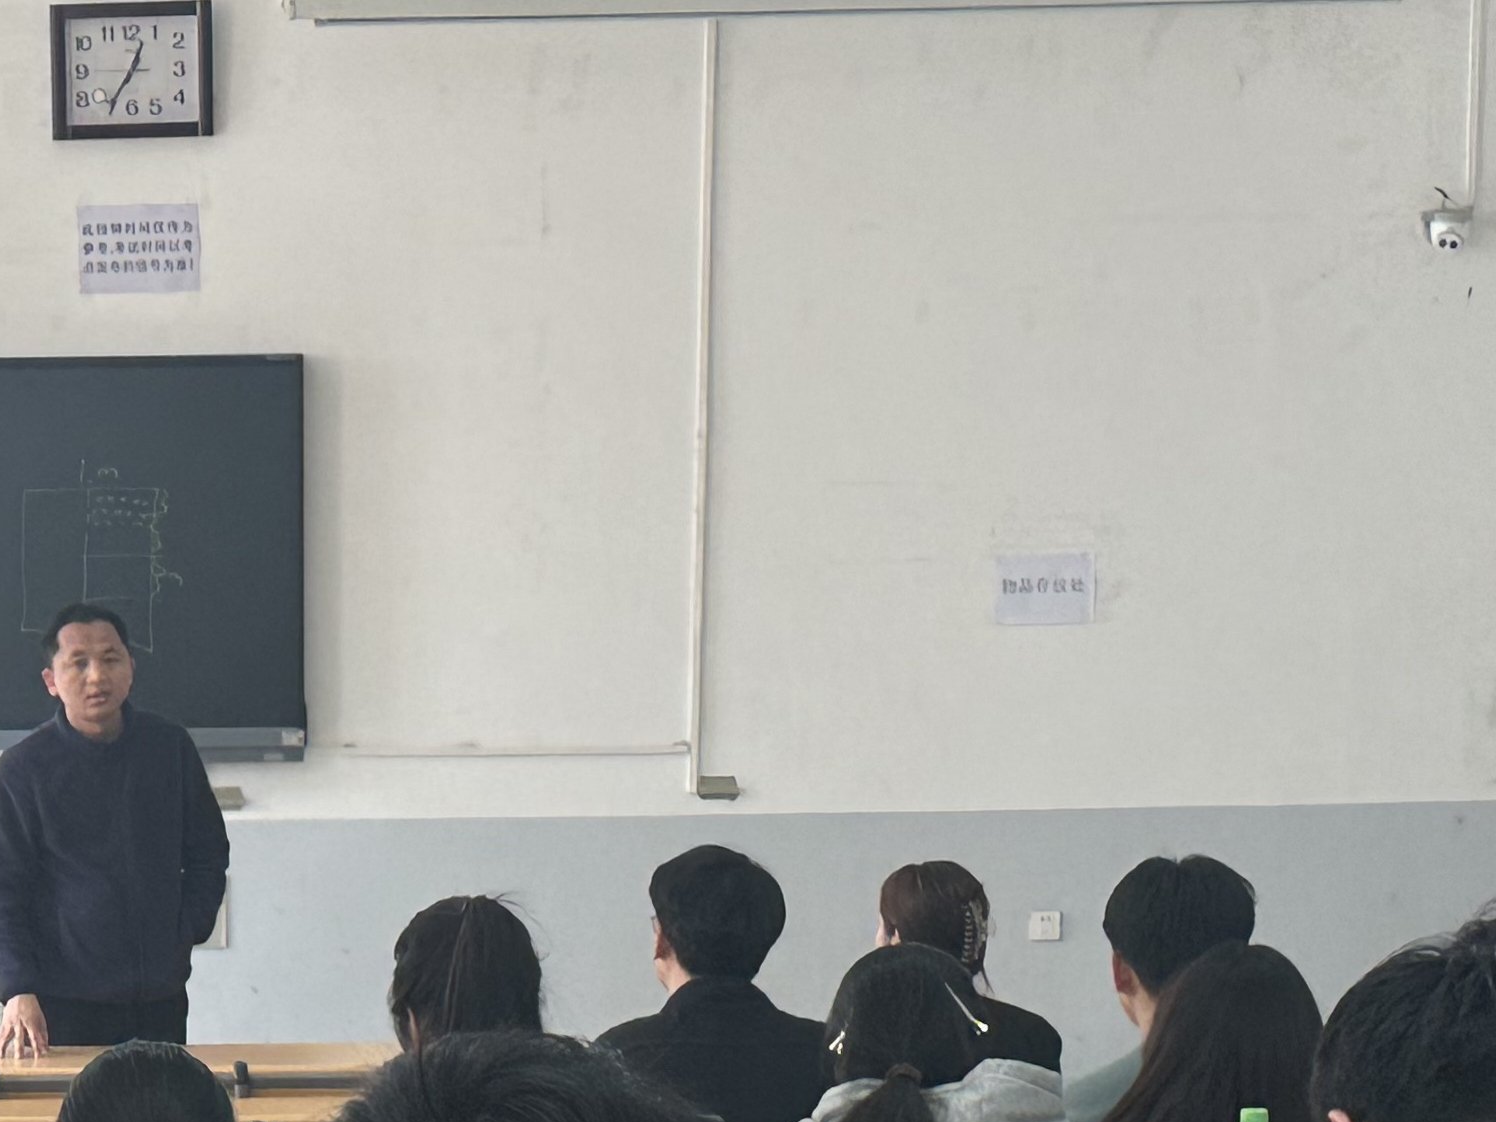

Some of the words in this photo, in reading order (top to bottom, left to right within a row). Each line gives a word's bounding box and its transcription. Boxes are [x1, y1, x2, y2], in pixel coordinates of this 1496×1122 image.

[102, 25, 114, 42] 11
[122, 24, 141, 41] 12
[172, 32, 186, 49] 2
[75, 35, 92, 51] 10
[75, 63, 90, 80] 9
[172, 61, 186, 77] 3
[75, 91, 90, 108] 8
[173, 89, 185, 105] 4
[125, 99, 139, 116] 6
[149, 98, 163, 116] 5
